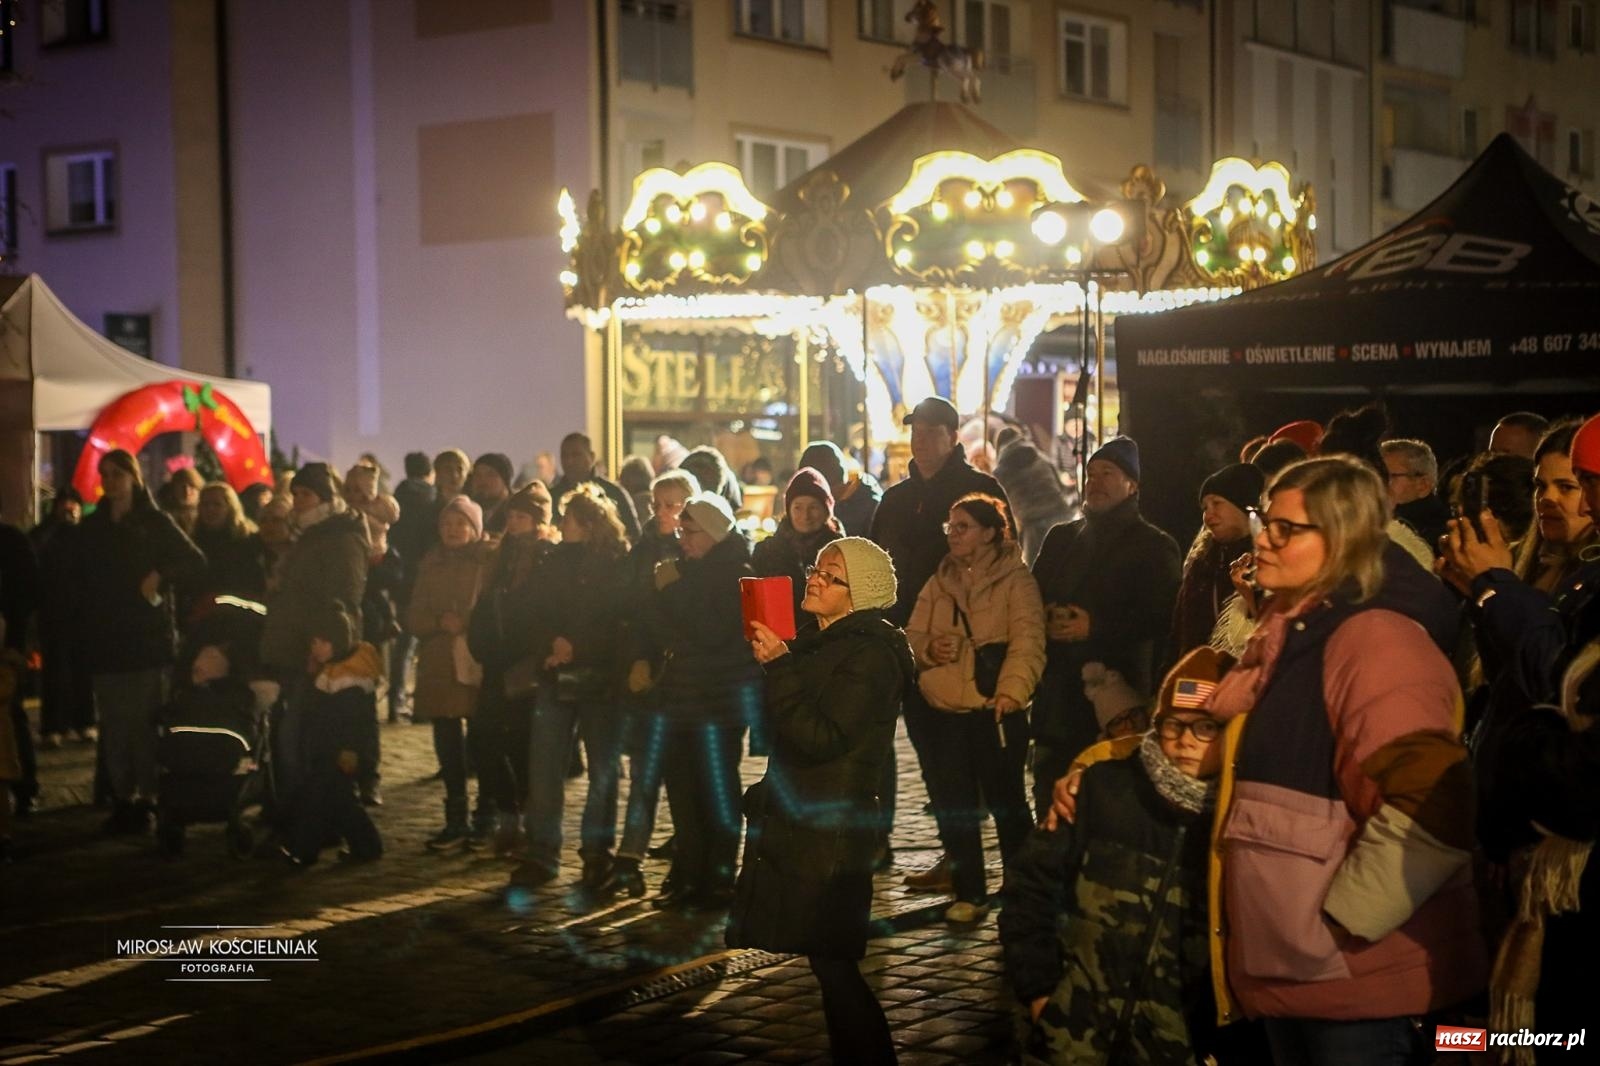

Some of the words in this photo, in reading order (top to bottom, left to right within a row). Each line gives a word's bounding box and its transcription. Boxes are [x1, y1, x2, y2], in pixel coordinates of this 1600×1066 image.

[1137, 344, 1230, 366] NAGŁOŚNIENIE
[1245, 342, 1335, 364] OŚWIETLENIE
[1351, 343, 1399, 362] SCENA
[1415, 338, 1491, 359] WYNAJEM
[1508, 336, 1538, 355] +48
[1543, 333, 1572, 352] 607
